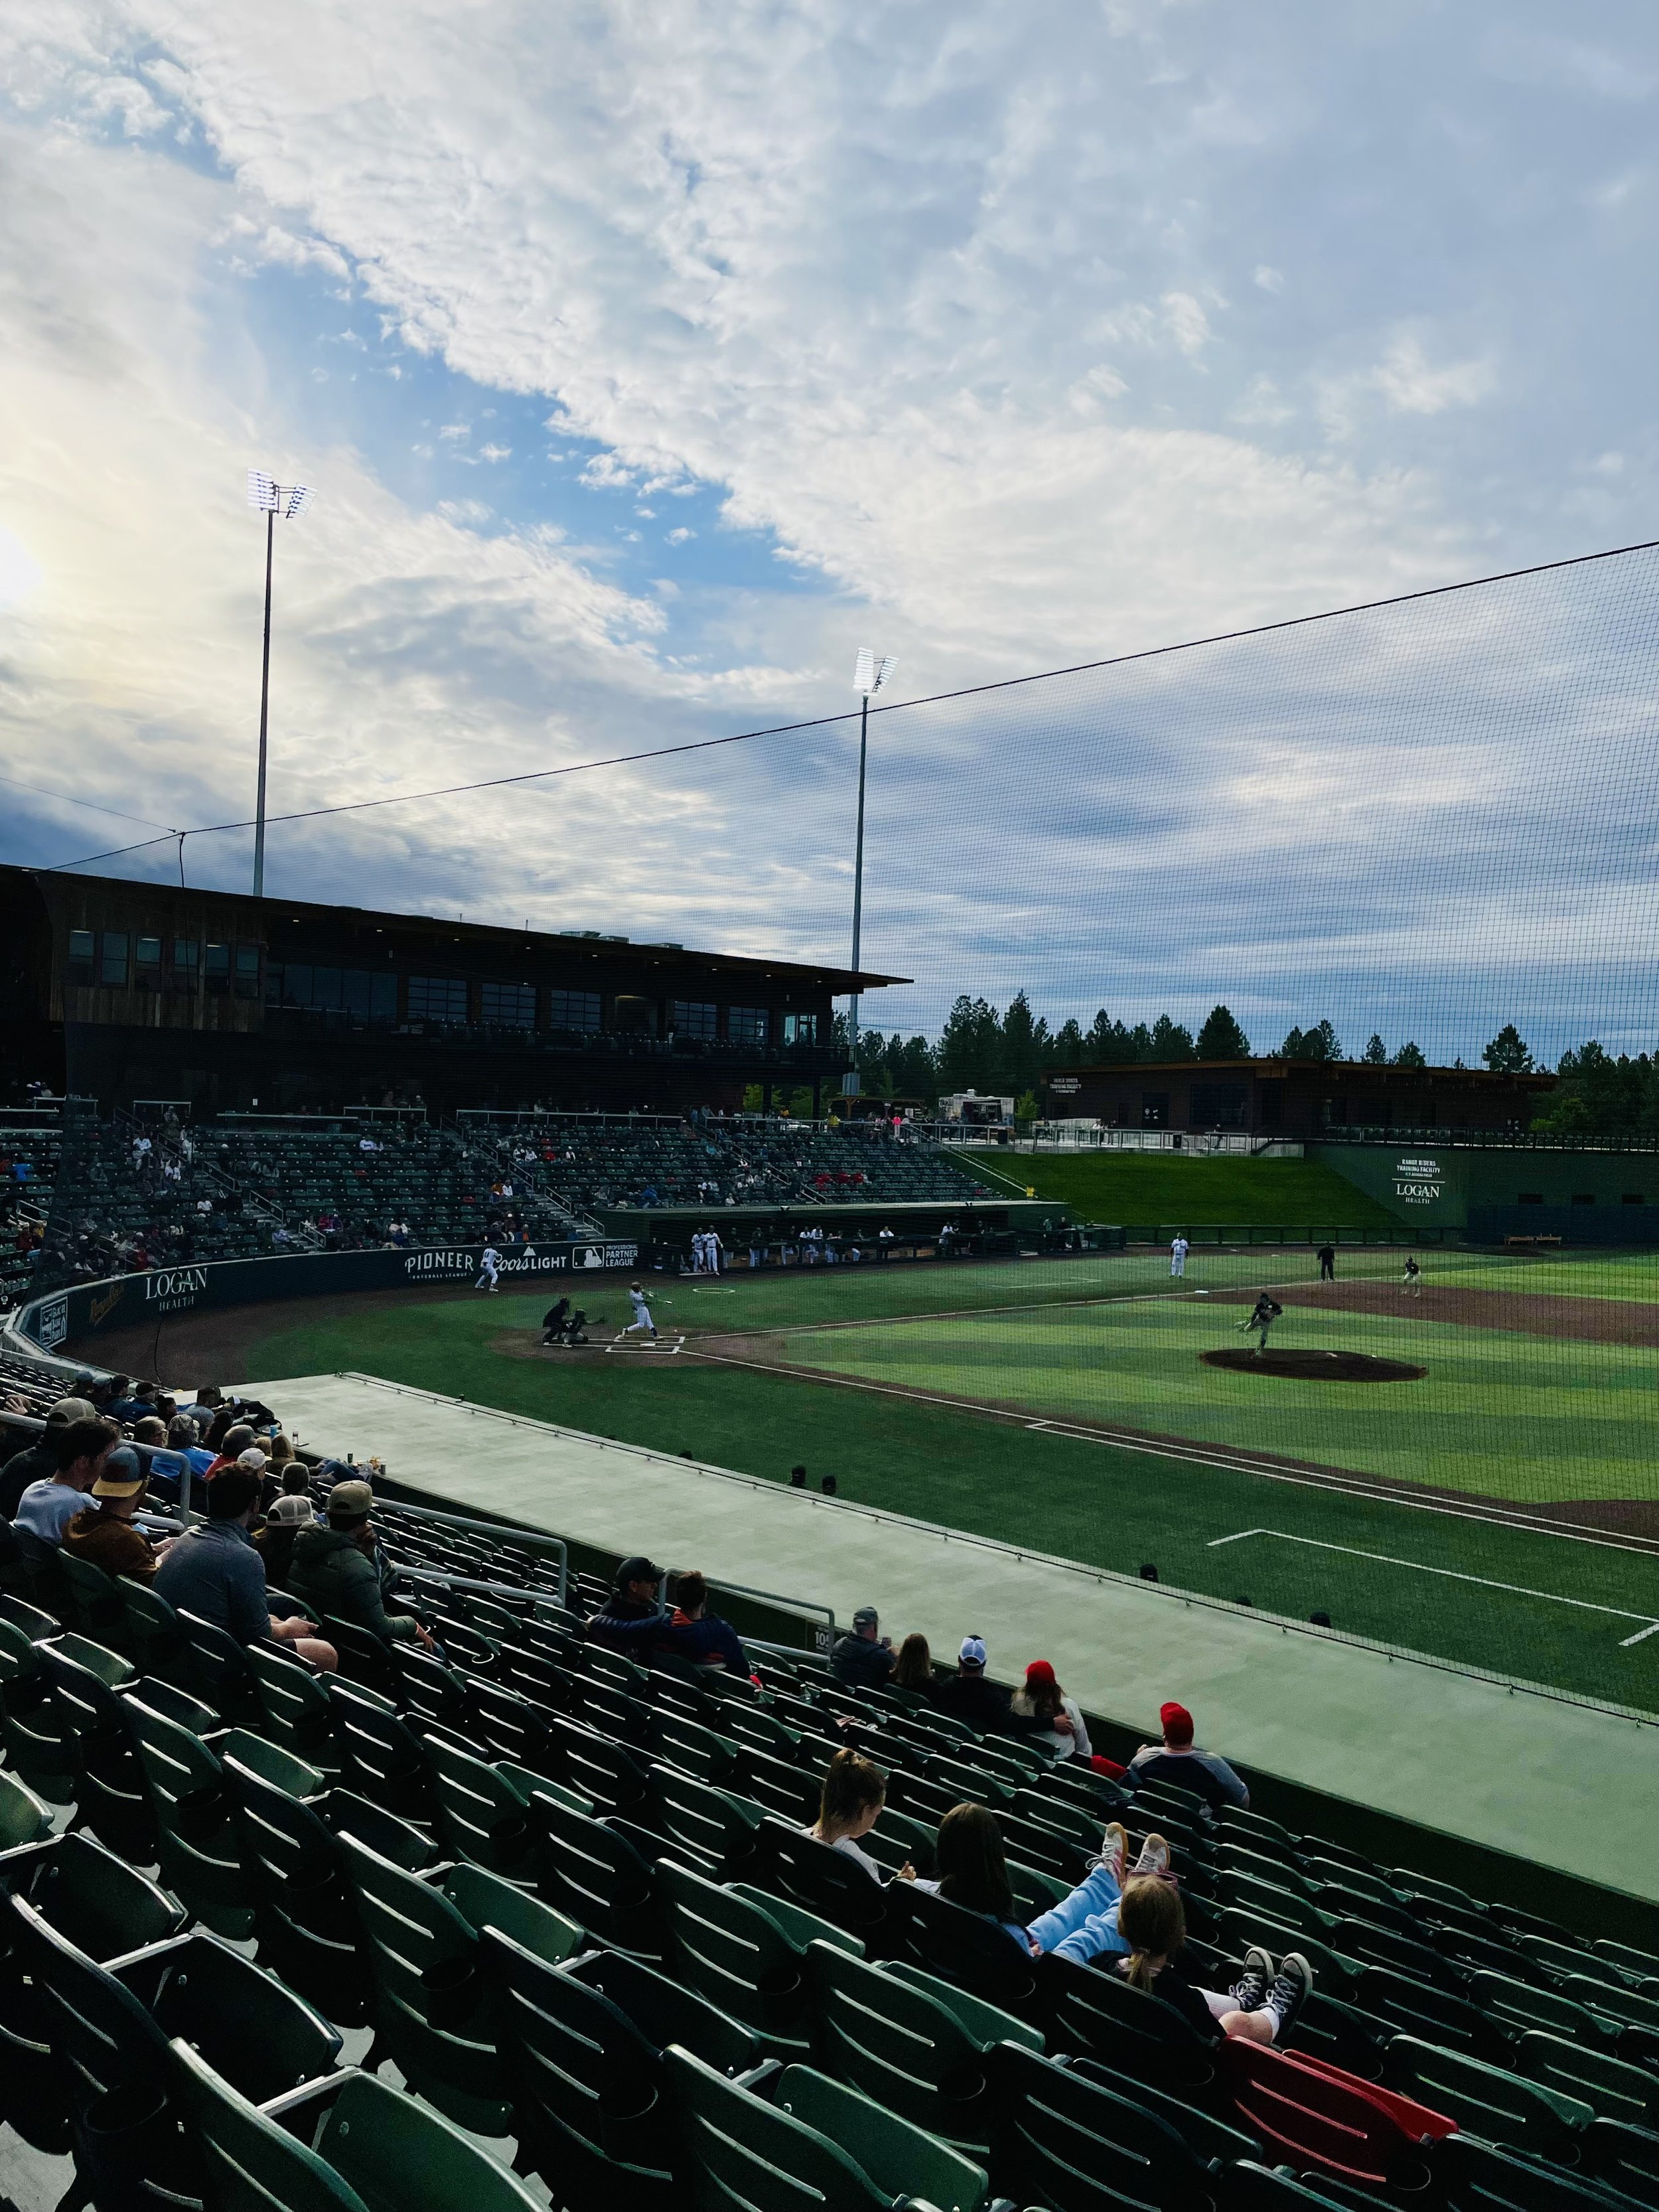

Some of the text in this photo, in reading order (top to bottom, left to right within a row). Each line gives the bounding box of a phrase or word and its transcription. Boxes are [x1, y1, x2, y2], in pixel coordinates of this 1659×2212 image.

[1396, 1184, 1439, 1198] LOGAN
[606, 1250, 638, 1258] PARTNER
[405, 1252, 474, 1273] PIONEER
[494, 1254, 530, 1272] Coors
[532, 1256, 567, 1270] LIGHT
[606, 1258, 634, 1267] LEAGUE
[145, 1268, 208, 1299] LOGAN
[159, 1295, 194, 1311] HEALTH
